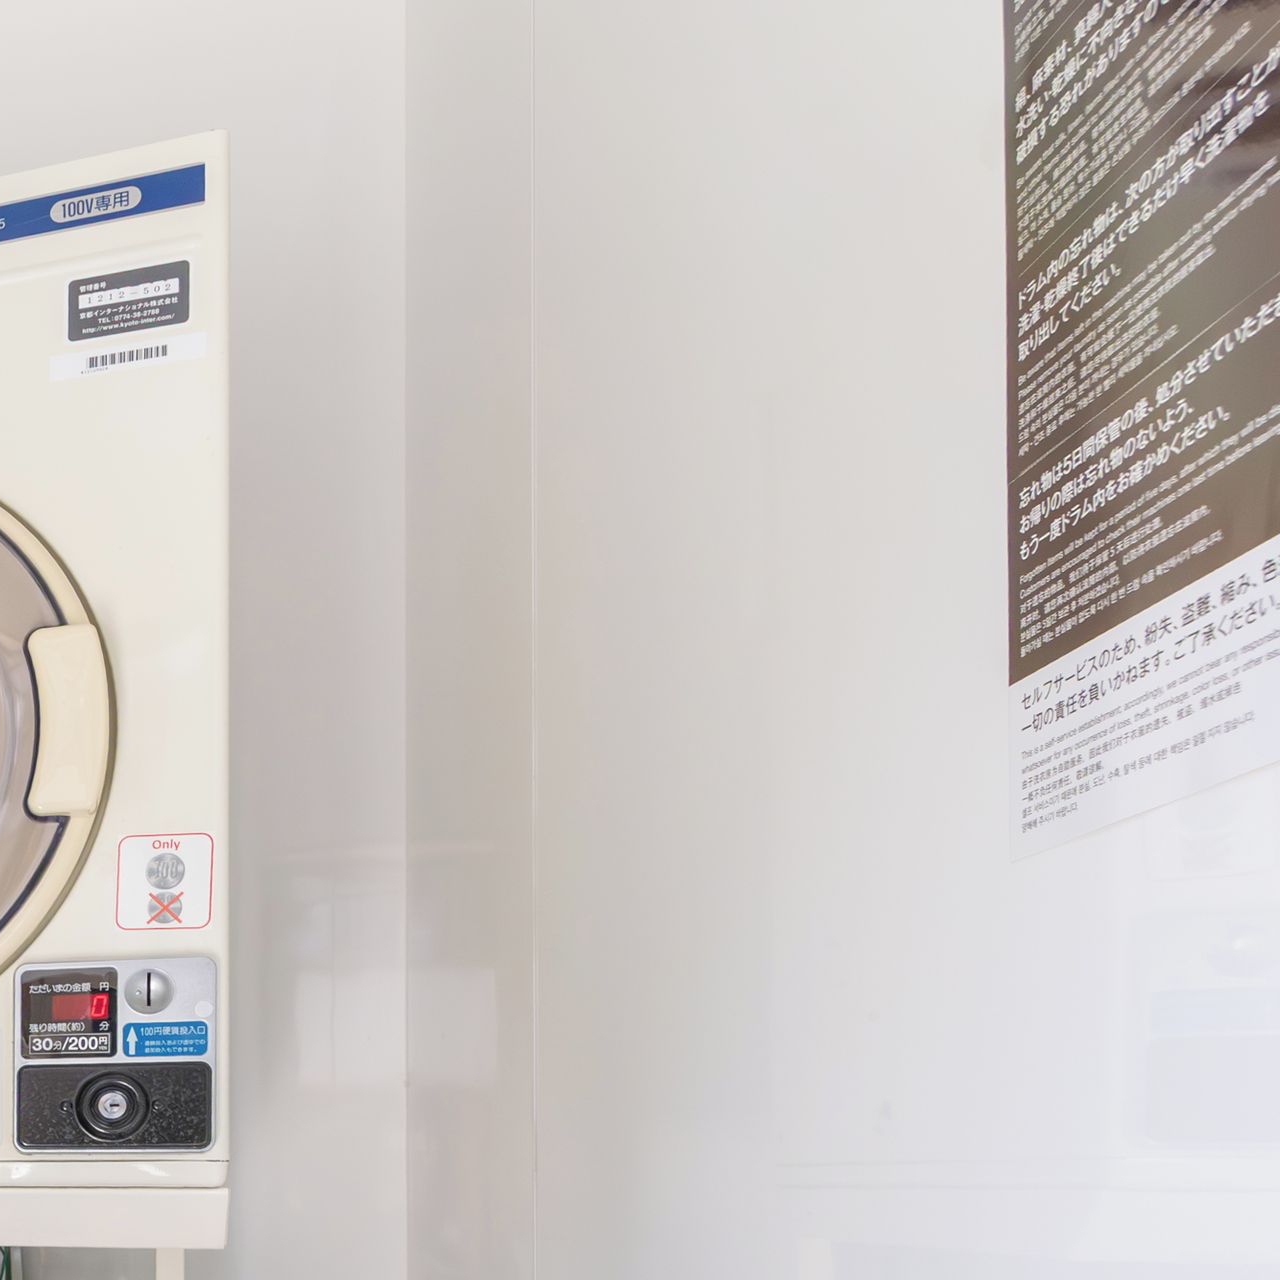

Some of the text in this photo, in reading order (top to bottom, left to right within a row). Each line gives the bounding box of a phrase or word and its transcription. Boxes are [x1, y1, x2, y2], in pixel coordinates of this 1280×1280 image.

[61, 191, 130, 218] 100V専用
[79, 281, 107, 293] 管理番号
[80, 296, 179, 319] 京都インターナショナル株式会社
[1017, 251, 1121, 366] 取り出してください。
[1019, 389, 1195, 537] お帰りの際は忘れ物のないよう、
[1019, 395, 1230, 563] もう一度ドラム内をお確かめください。
[1021, 585, 1279, 740] 一切の責任を負いかねます。ご了承ください。
[152, 839, 180, 850] Only
[29, 982, 109, 993] ただいまの金額 円
[91, 995, 107, 1017] 0
[99, 1022, 109, 1031] 分
[140, 1026, 205, 1036] 100円硬貨投入口
